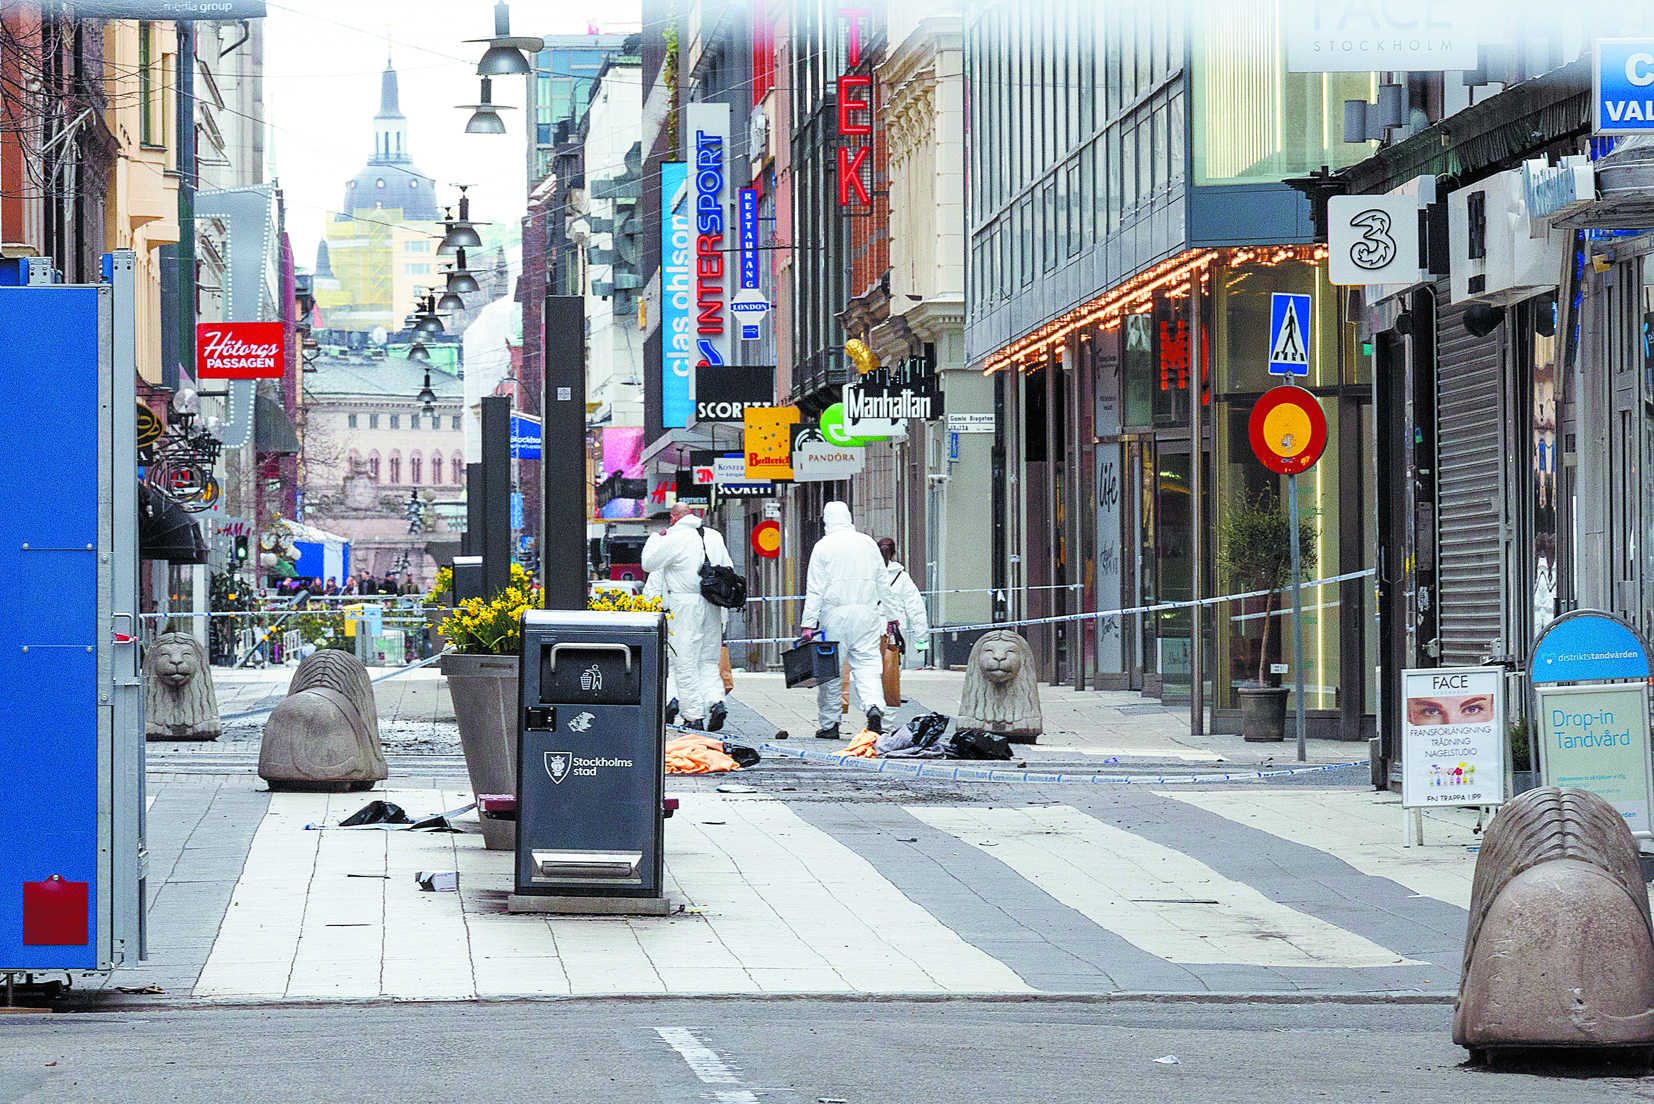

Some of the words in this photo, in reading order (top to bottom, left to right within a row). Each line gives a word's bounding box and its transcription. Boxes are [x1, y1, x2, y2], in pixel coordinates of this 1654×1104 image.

[199, 3, 233, 12] group
[1313, 40, 1453, 51] STOCKHOLM
[696, 130, 724, 334] INTERSPORT
[744, 192, 754, 288] RESTAURANG
[666, 214, 690, 311] ohlson
[733, 303, 768, 311] LONDON
[203, 331, 279, 359] Hötorgs
[666, 314, 690, 378] clas
[206, 357, 275, 369] PASSAGEN
[849, 388, 931, 418] Manhattan
[808, 452, 855, 462] PANDORA
[1558, 651, 1638, 662] distriktstandvården
[1433, 675, 1469, 689] FACE
[1552, 709, 1614, 731] Drop-in
[1410, 725, 1492, 737] FRANSFÖRLÄNGNING
[1554, 728, 1630, 749] Tandvård
[1425, 747, 1478, 758] NAGELSTUDIO
[573, 757, 633, 767] Stockholms
[573, 767, 597, 776] stad
